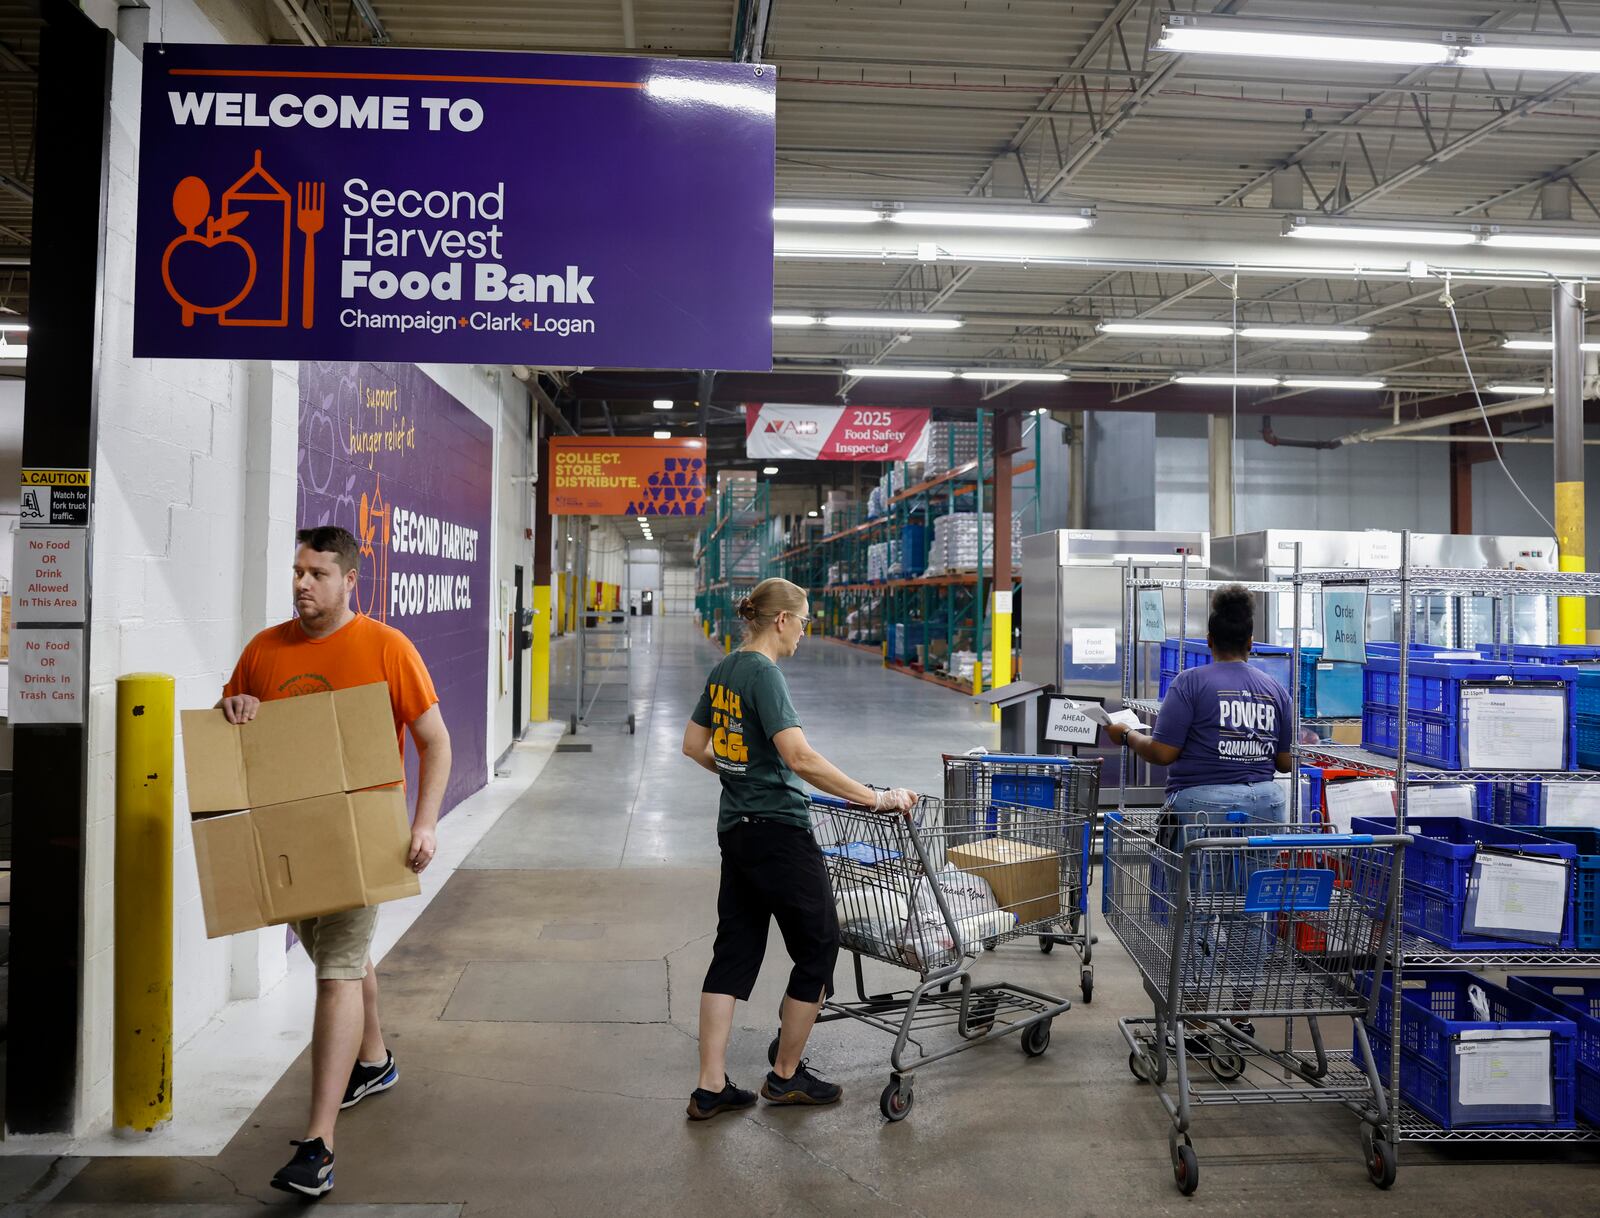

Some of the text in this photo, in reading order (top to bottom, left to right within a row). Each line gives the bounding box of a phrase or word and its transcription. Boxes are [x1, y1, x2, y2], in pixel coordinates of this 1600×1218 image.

[168, 91, 484, 132] WELCOME TO
[343, 178, 505, 220] Second
[343, 217, 503, 259] Harvest
[341, 260, 595, 304] Food Bank
[366, 381, 398, 426] support
[853, 411, 892, 426] 2025
[844, 429, 906, 443] Food Safety
[349, 415, 415, 471] hunger relief at
[835, 443, 888, 456] Inspected
[555, 453, 621, 464] COLLECT.
[555, 465, 605, 476] STORE.
[31, 473, 86, 484] CAUTION
[555, 476, 641, 488] DISTRIBUTE.
[53, 491, 87, 499] Watch for
[53, 501, 87, 510] fork truck
[53, 512, 75, 520] traffic.
[392, 506, 478, 562] SECOND HARVEST
[29, 540, 70, 549] No Food
[42, 555, 57, 564] OR
[36, 569, 62, 578] Drink
[28, 583, 69, 593] Allowed
[391, 572, 471, 616] FOOD BANK CCL
[19, 598, 77, 607] In This Area
[1334, 604, 1354, 618] Order
[1334, 630, 1357, 644] Ahead
[26, 641, 70, 650] No Food
[40, 657, 55, 667] OR
[24, 674, 70, 683] Drinks In
[20, 691, 75, 700] Trash Cans
[1061, 714, 1086, 722] AHEAD
[1219, 700, 1276, 732] POWER
[1054, 724, 1090, 734] PROGRAM
[938, 883, 985, 900] Thank You
